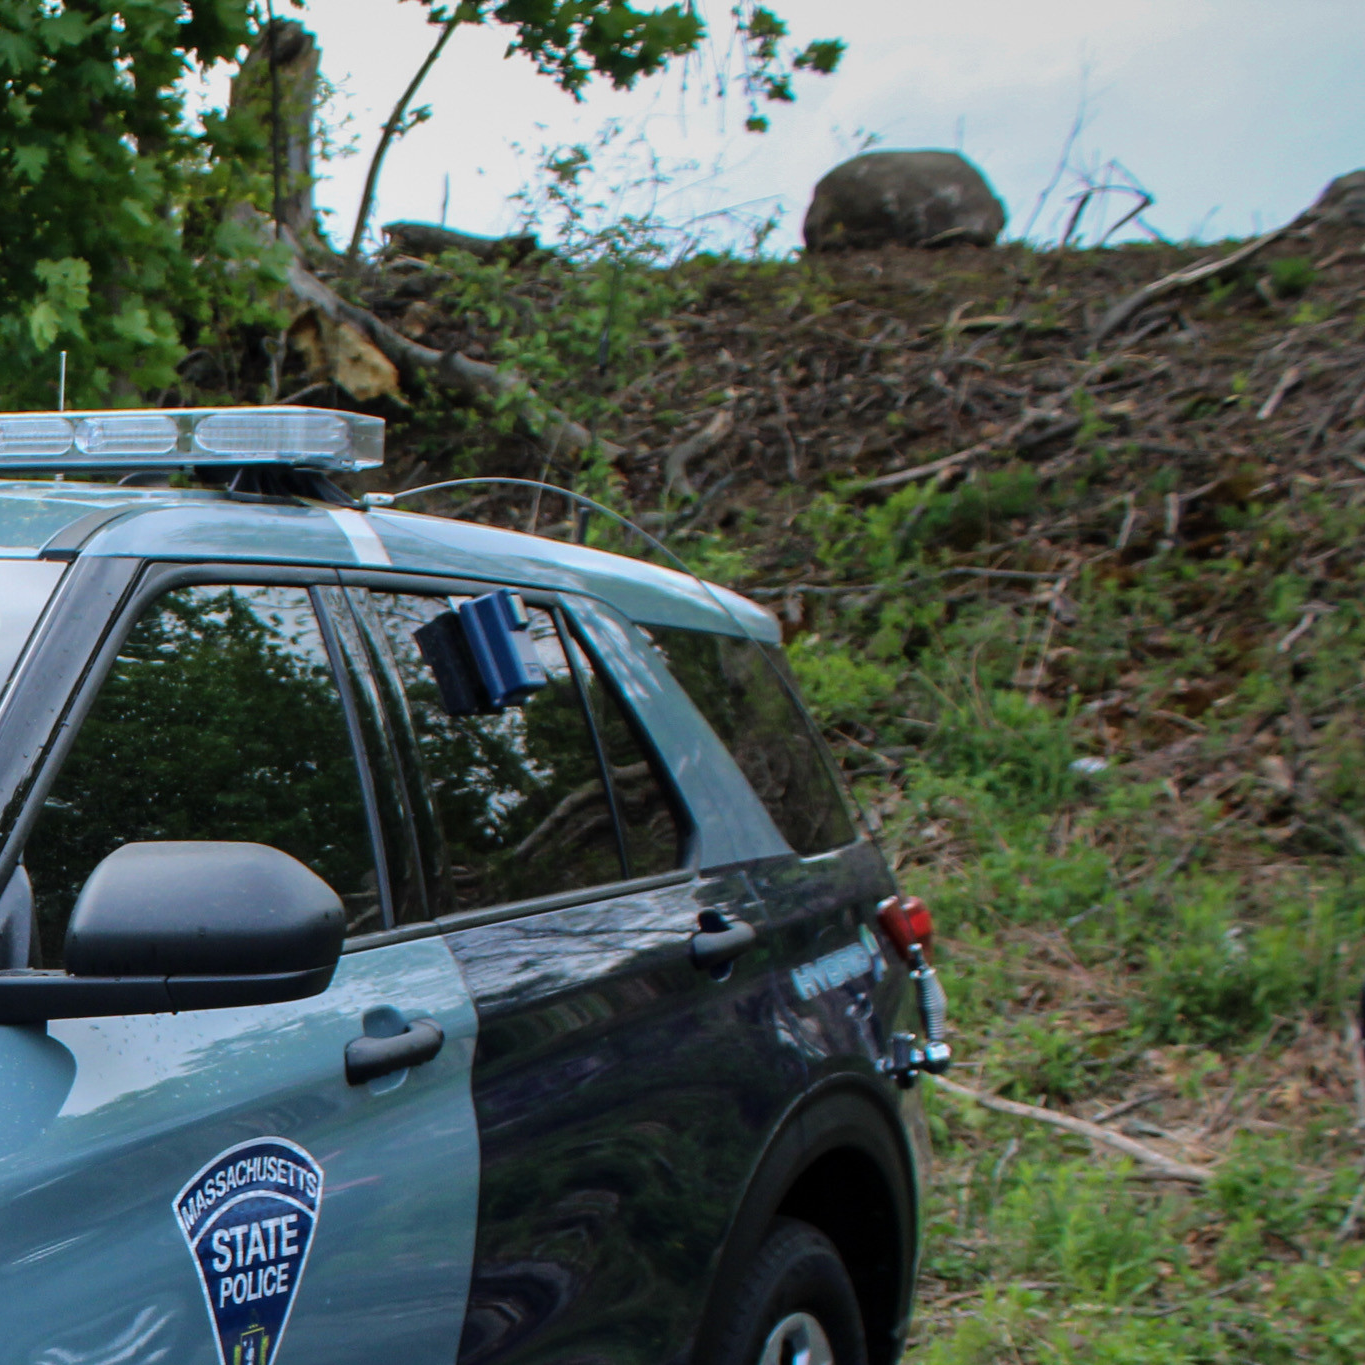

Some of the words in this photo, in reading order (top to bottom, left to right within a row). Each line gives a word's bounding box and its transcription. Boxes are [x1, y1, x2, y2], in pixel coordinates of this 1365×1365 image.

[180, 1155, 319, 1231] MASSACHUSETTS
[211, 1213, 300, 1274] STATE
[218, 1262, 290, 1309] POLICE
